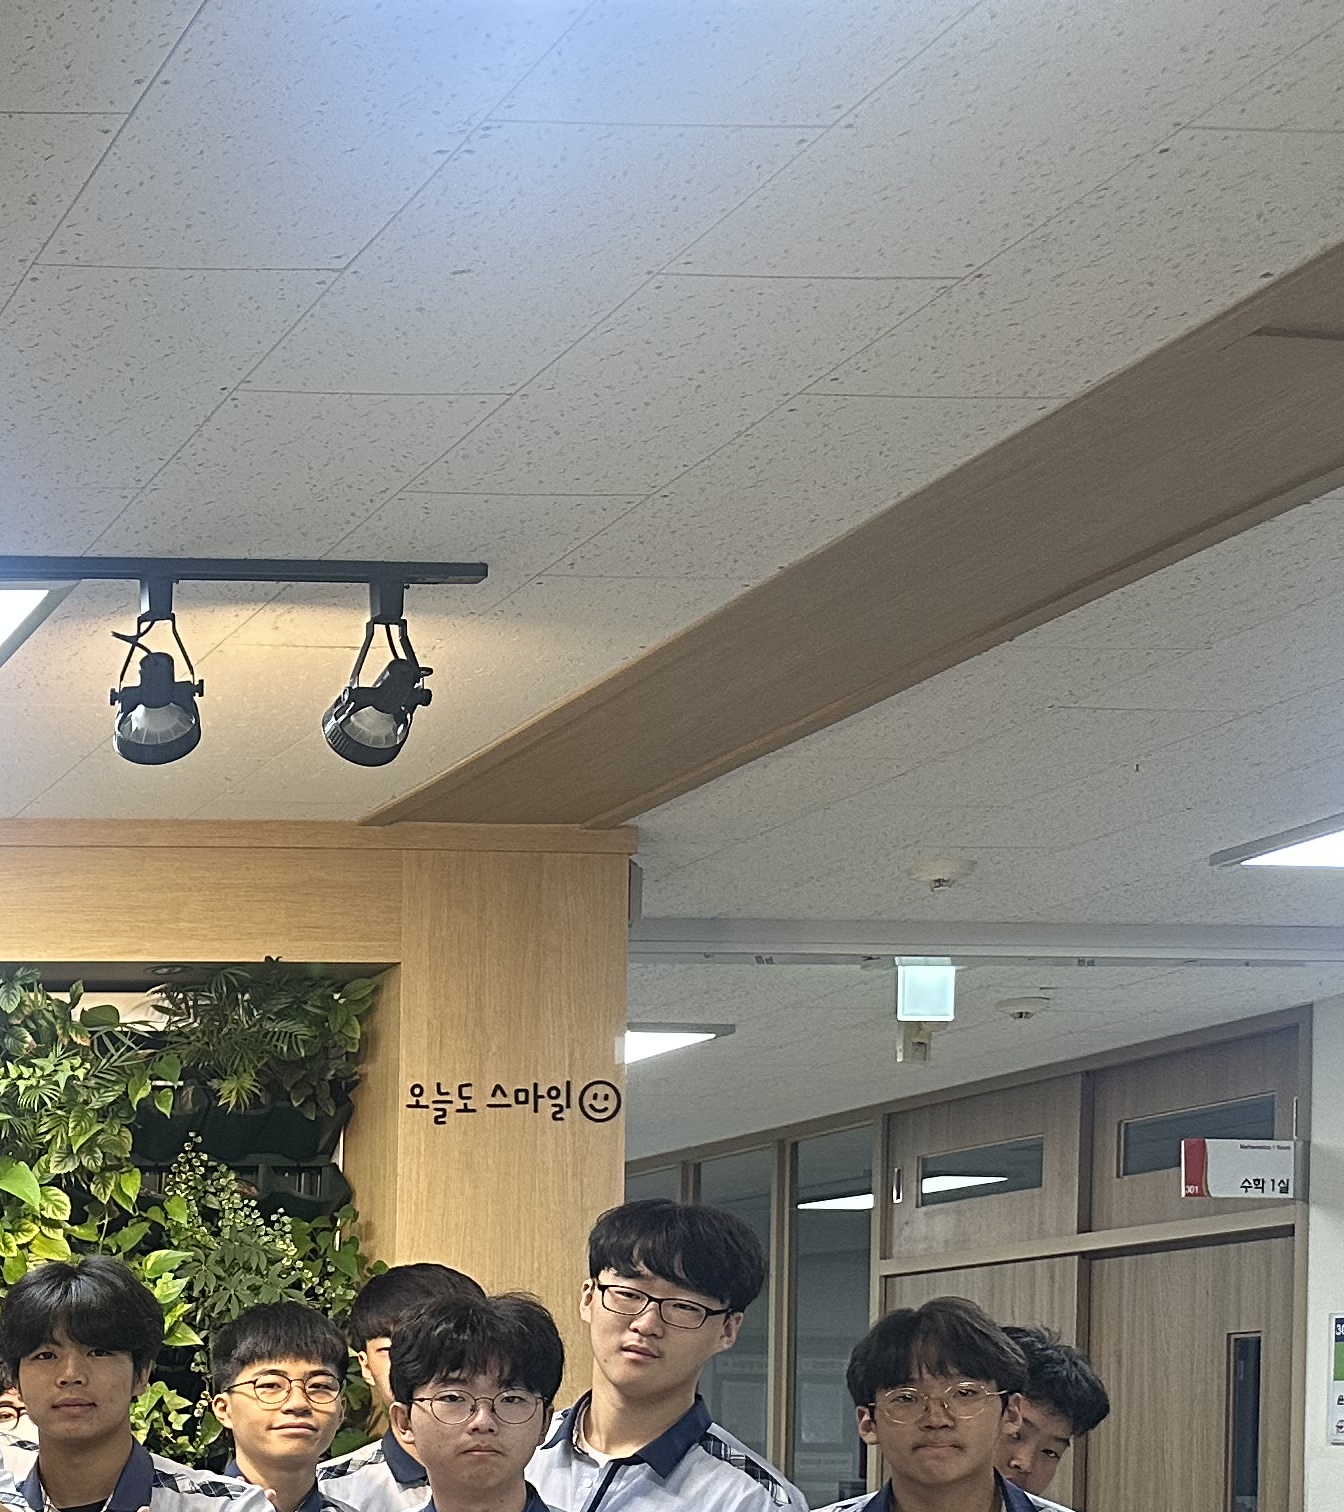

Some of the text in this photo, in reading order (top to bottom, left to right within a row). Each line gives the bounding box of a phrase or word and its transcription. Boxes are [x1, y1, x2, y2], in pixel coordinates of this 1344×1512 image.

[406, 1080, 571, 1125] 오늘도 스마일
[1240, 1178, 1266, 1194] 수학
